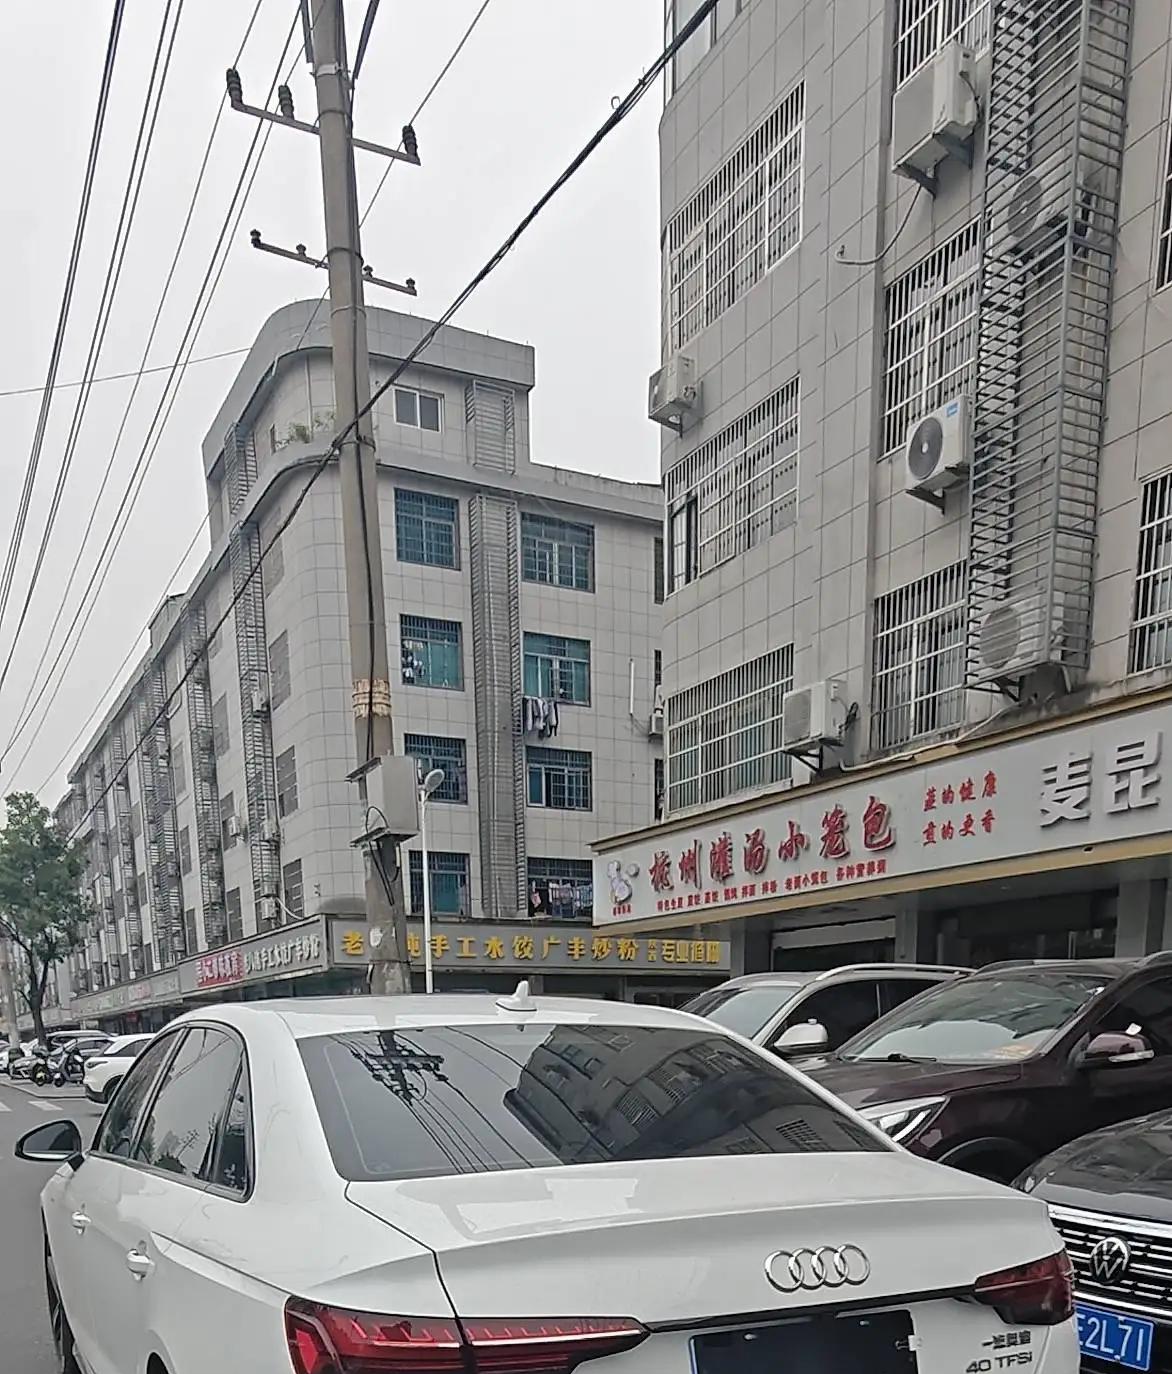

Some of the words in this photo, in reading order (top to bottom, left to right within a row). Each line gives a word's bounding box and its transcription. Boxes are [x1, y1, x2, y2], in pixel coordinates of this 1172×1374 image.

[923, 770, 998, 812] 蒸的健康
[1040, 731, 1163, 828] 麦昆
[649, 795, 896, 894] 杭州灌汤小笼包
[965, 1360, 991, 1374] 40
